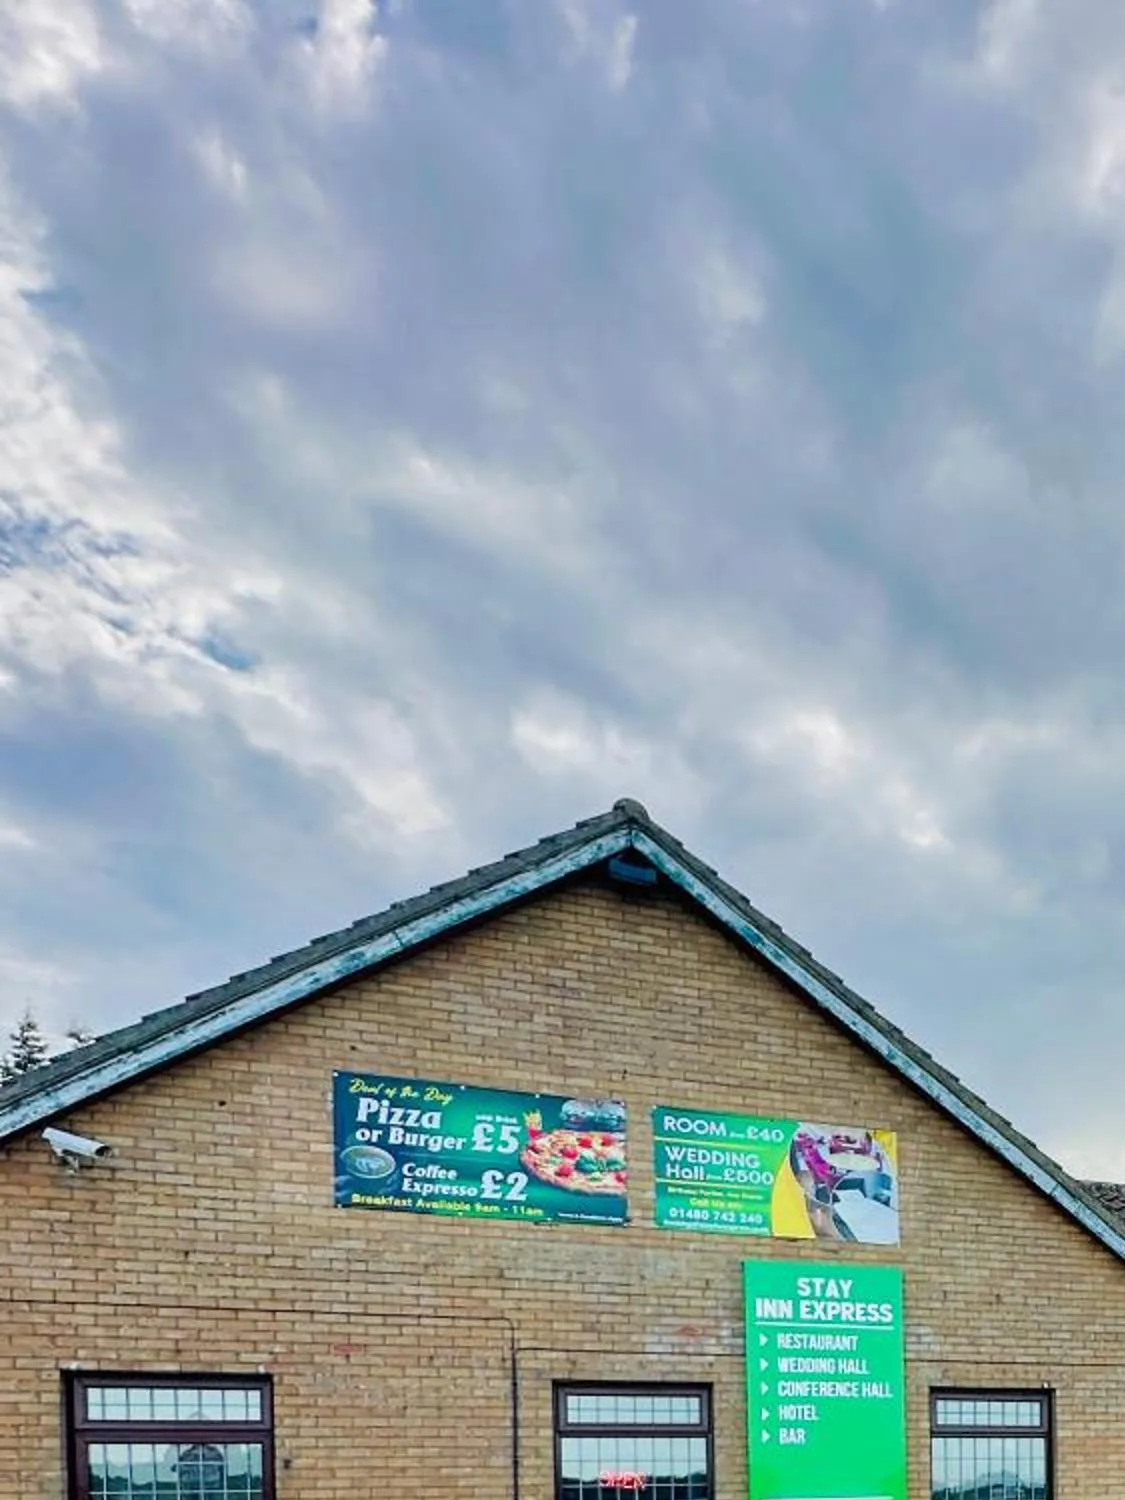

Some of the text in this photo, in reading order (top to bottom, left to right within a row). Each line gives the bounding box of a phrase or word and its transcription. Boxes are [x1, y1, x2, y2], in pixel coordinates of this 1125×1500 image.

[424, 1087, 453, 1106] Day
[356, 1097, 442, 1128] Pizza
[355, 1126, 467, 1152] or Burger
[471, 1122, 522, 1154] £5
[663, 1115, 784, 1142] ROOM £40
[665, 1146, 760, 1168] WEDDING
[402, 1162, 457, 1180] Coffee
[666, 1163, 774, 1185] Hall £500
[402, 1178, 478, 1197] Expresso
[480, 1169, 529, 1201] £2
[351, 1193, 412, 1207] Breakfast
[416, 1198, 470, 1211] Available
[513, 1205, 543, 1216] 11am
[669, 1207, 709, 1220] 01480
[713, 1211, 735, 1222] 742
[797, 1277, 853, 1298] STAY
[755, 1298, 893, 1323] INN EXPRESS
[777, 1333, 859, 1350] RESTAURANT
[777, 1356, 870, 1375] WEDDING HALL
[777, 1380, 894, 1398] CONFERENCE HALL
[778, 1404, 820, 1421] HOTEL
[779, 1427, 806, 1445] BAR
